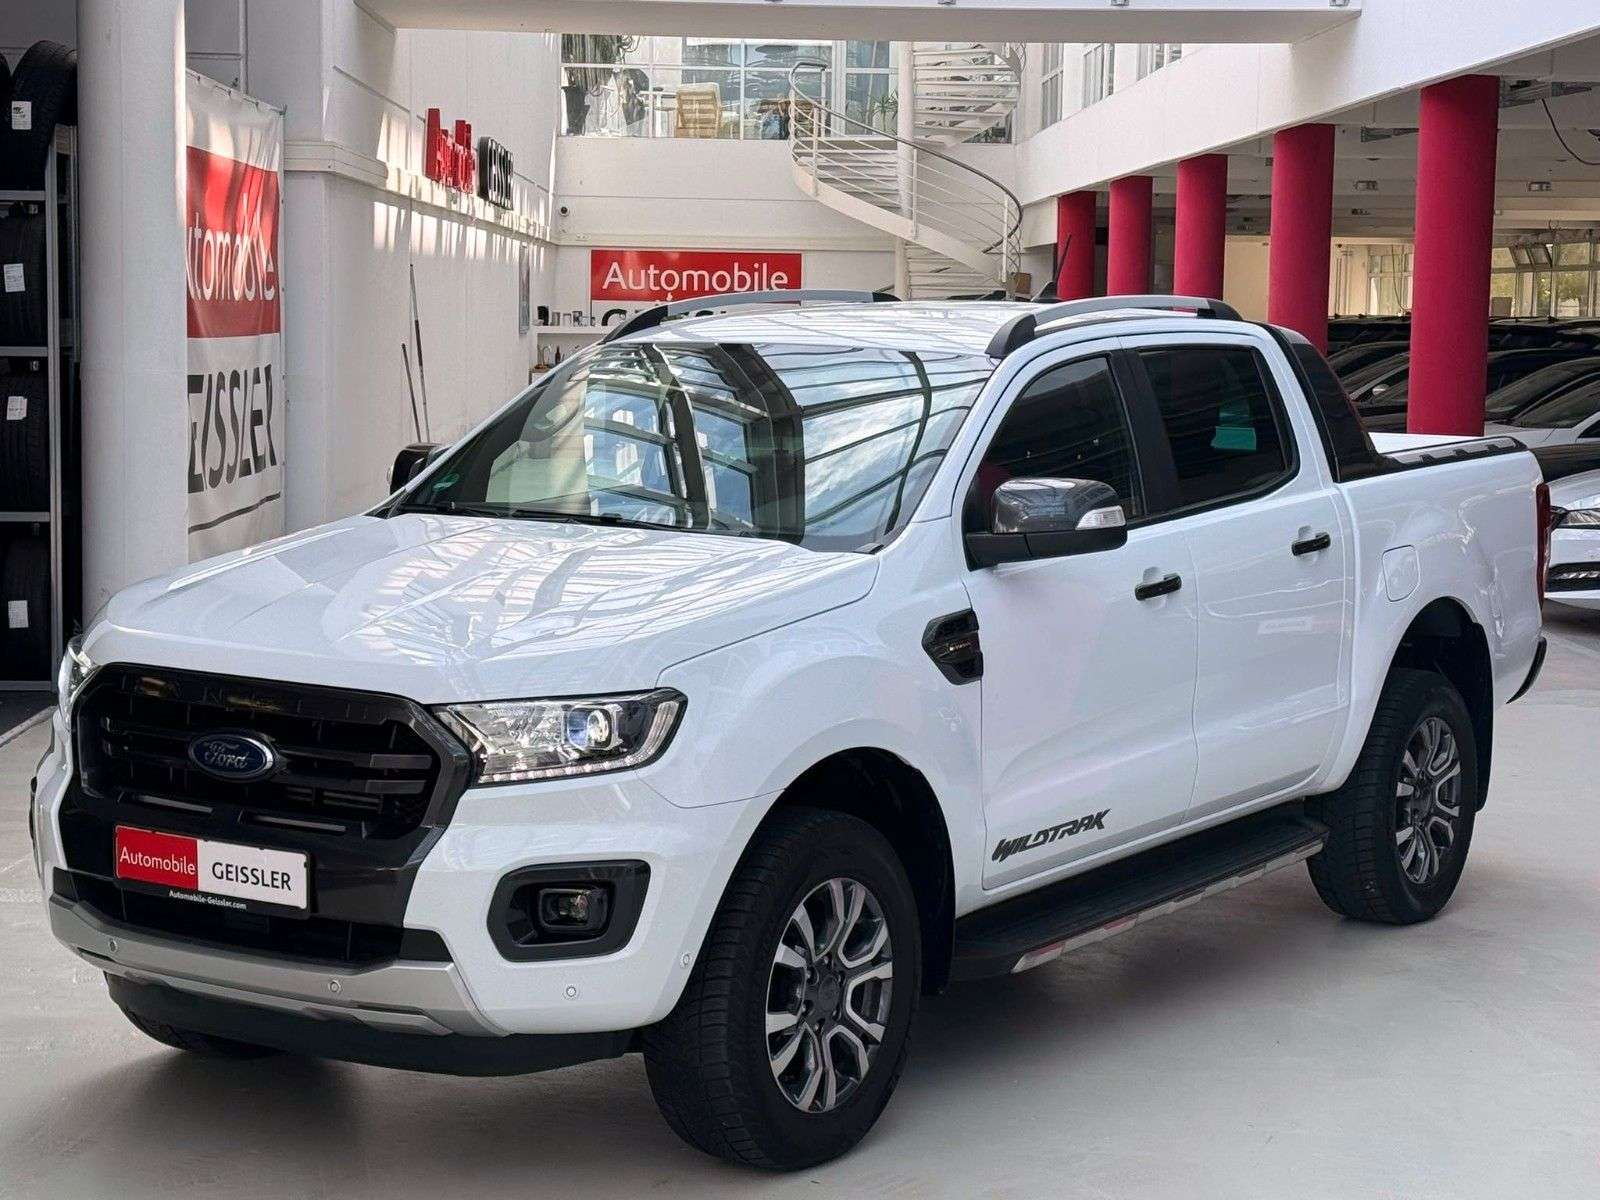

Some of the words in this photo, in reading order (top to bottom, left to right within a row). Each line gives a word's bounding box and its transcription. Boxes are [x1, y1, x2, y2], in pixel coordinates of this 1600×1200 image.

[602, 261, 789, 292] Automobile
[187, 364, 277, 494] EISSLER
[204, 740, 251, 769] Ford
[991, 808, 1111, 863] WILDTRAK
[119, 846, 196, 876] Automobile
[211, 862, 292, 891] GEISSLER
[168, 889, 247, 910] Automobile-Geissler.com
